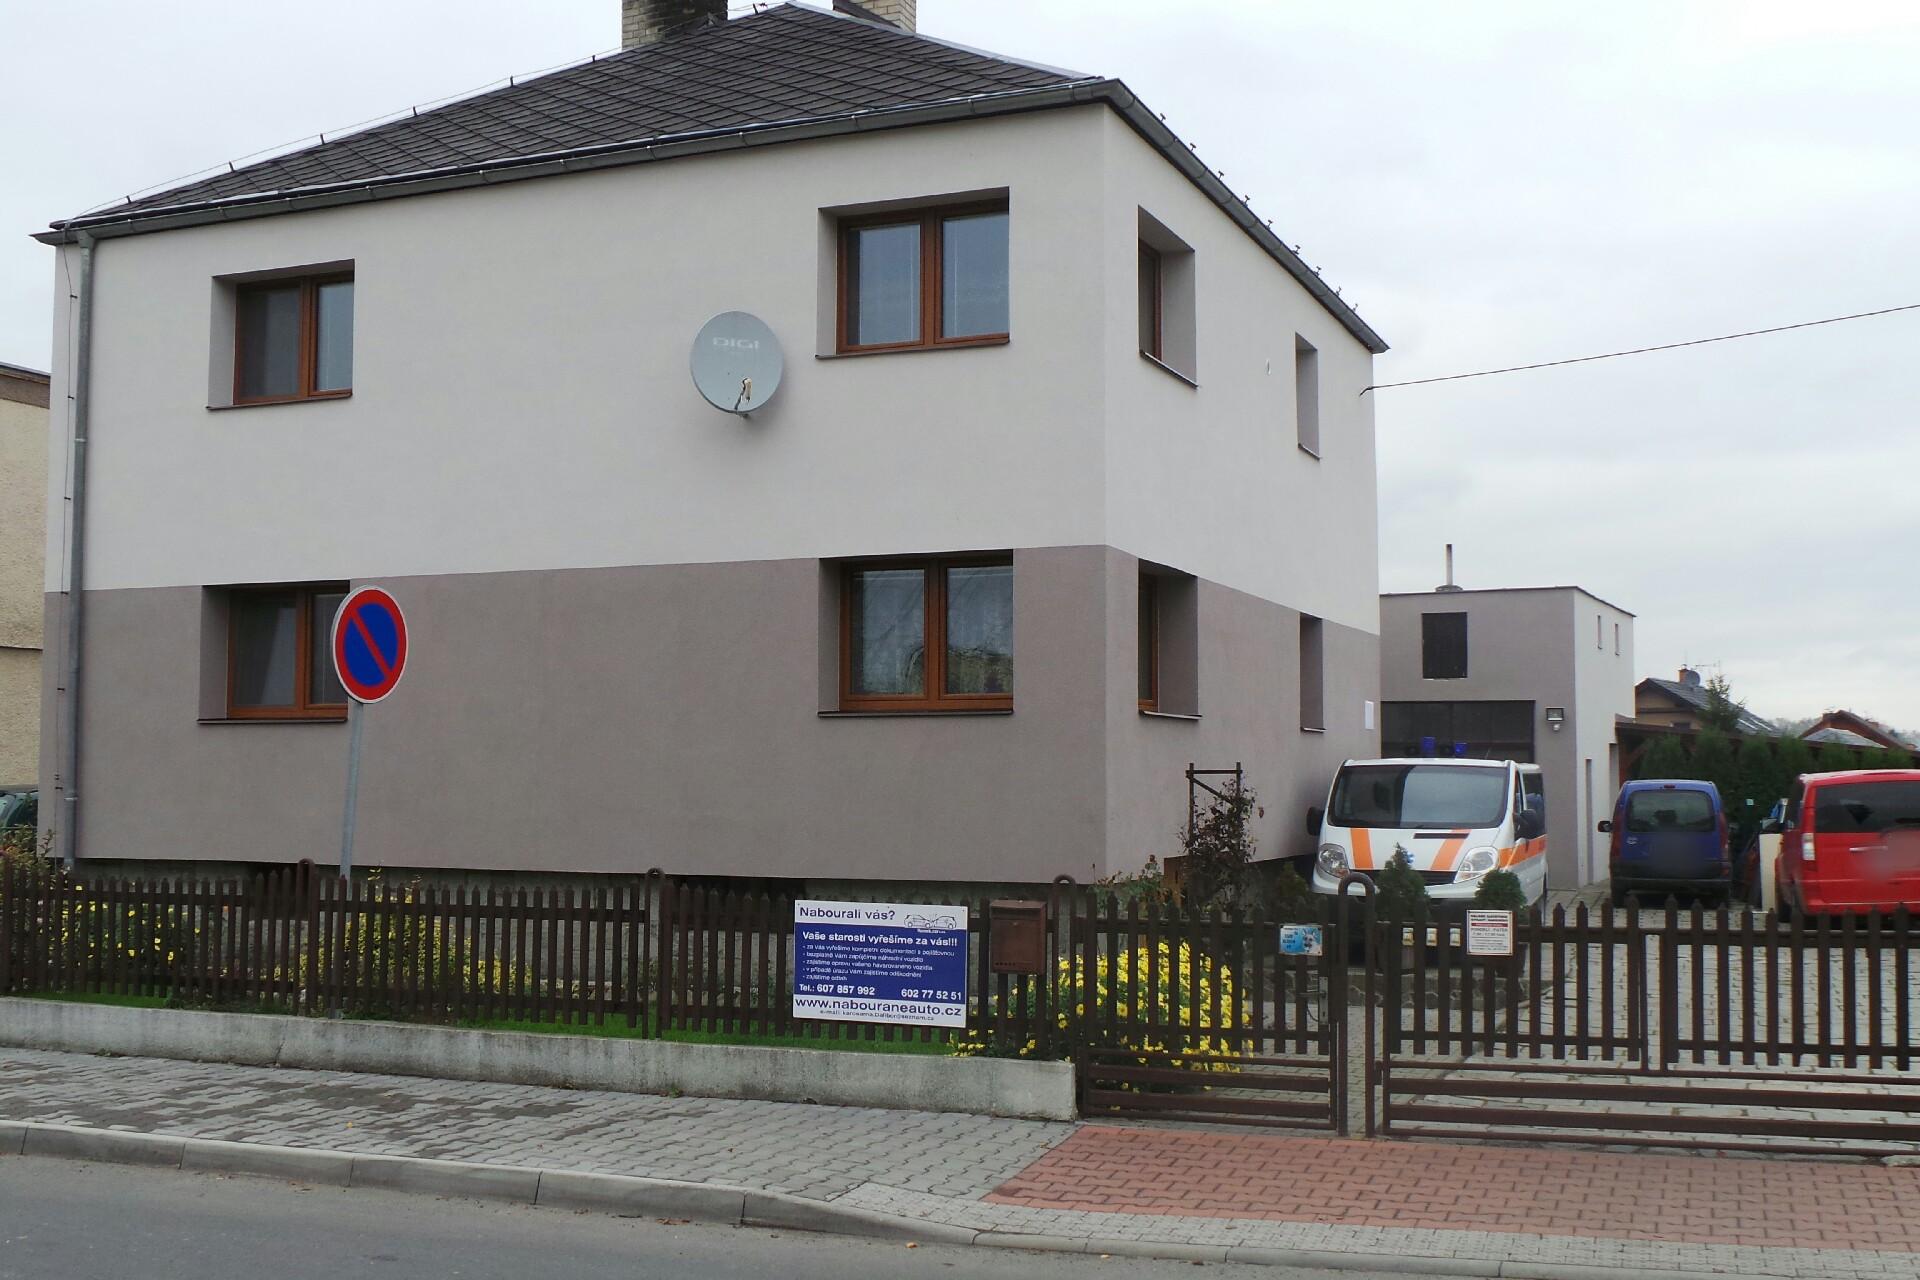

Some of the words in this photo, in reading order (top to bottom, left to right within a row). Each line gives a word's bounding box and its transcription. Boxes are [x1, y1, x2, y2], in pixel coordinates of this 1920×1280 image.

[713, 337, 760, 349] DIGI
[799, 907, 861, 920] Nabourali
[865, 909, 896, 920] vás?
[802, 931, 826, 941] Vaše
[828, 933, 866, 943] starosti
[868, 934, 914, 945] vyřešíme
[915, 937, 928, 945] za
[930, 937, 958, 947] vás!!!
[799, 984, 815, 992] Tel.:
[816, 983, 834, 993] 607
[857, 986, 876, 995] 992
[900, 988, 919, 998] 602
[922, 989, 934, 999] 77
[935, 990, 949, 1000] 52
[950, 991, 962, 1001] 51
[795, 998, 962, 1017] www.nabouraneauto.cz
